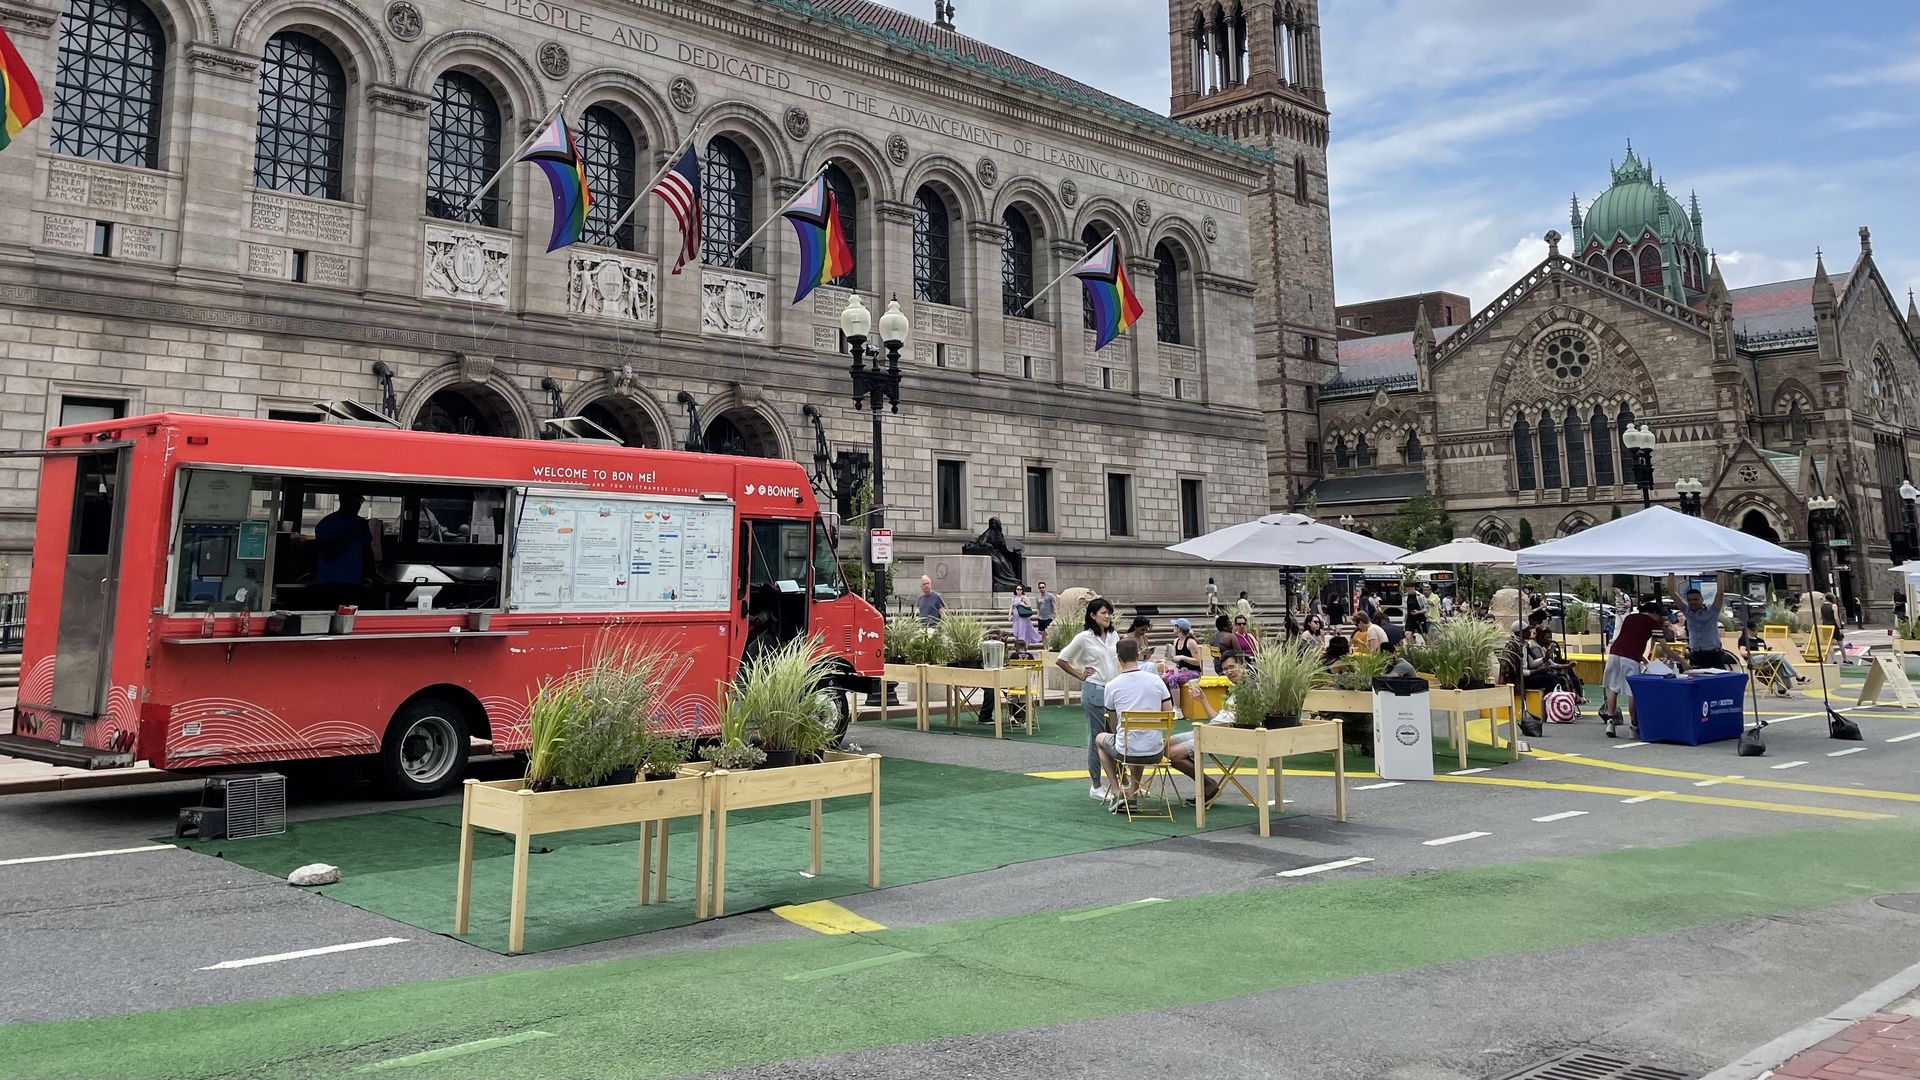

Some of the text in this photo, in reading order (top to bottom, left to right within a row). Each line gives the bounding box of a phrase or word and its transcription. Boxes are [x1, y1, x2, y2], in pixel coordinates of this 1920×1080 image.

[612, 26, 659, 53] AND
[678, 43, 791, 90] DEDICATED
[806, 80, 832, 101] TO
[843, 90, 878, 115] THE
[888, 105, 1003, 148] ADVANCEMENT
[1013, 139, 1033, 155] OF
[1043, 147, 1110, 178] LEARNING
[533, 466, 656, 483] WELCOME TO BON ME!
